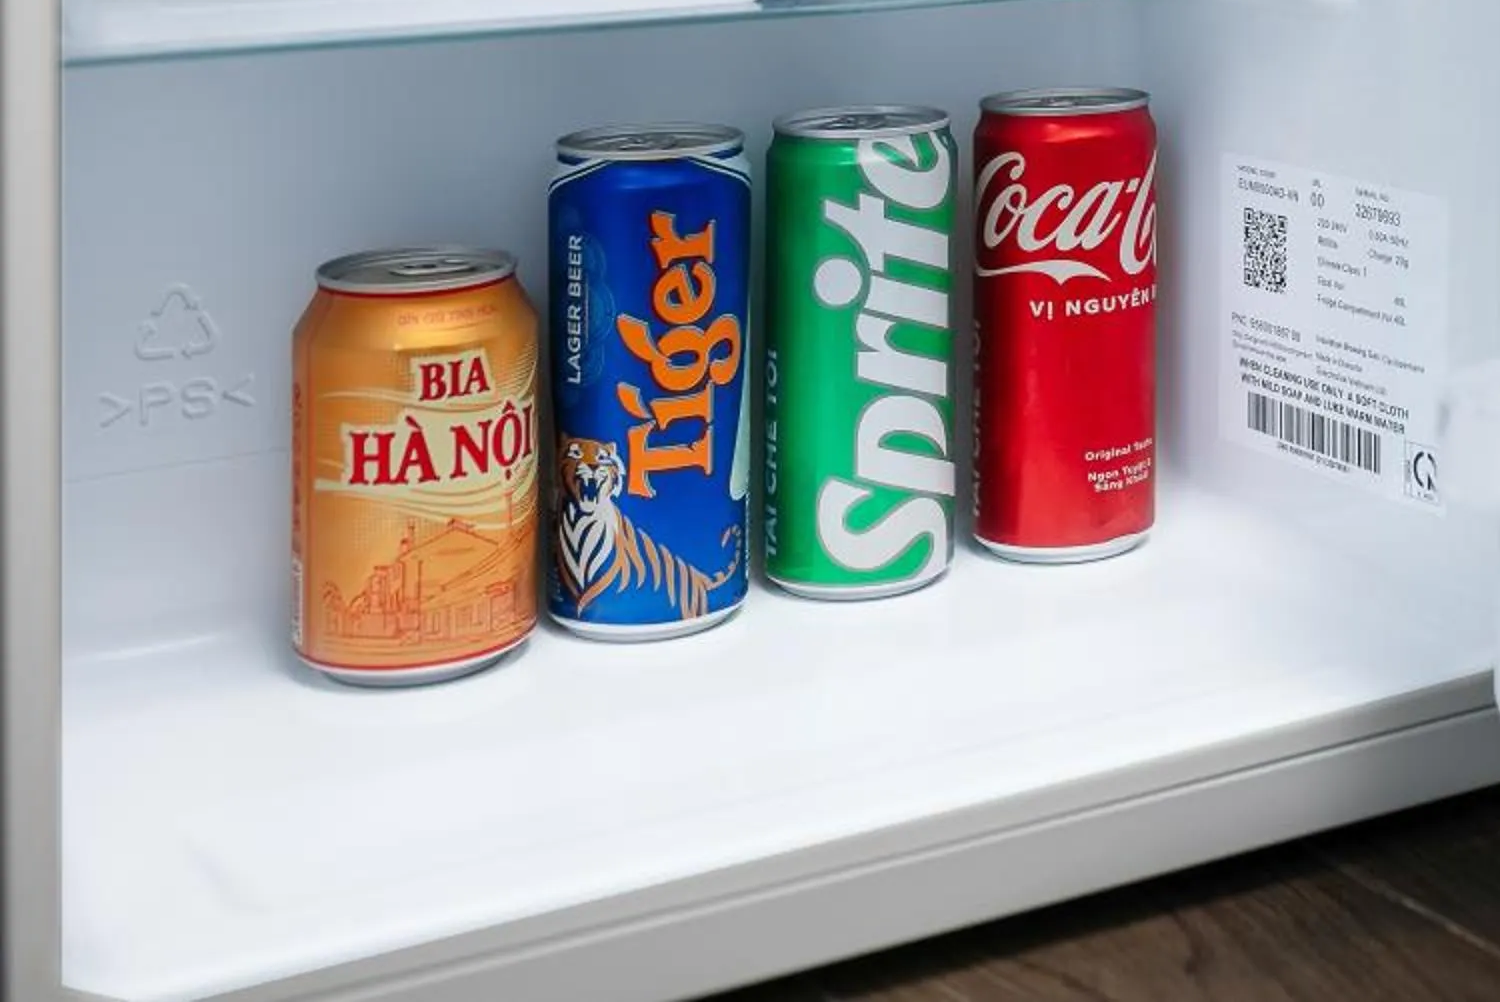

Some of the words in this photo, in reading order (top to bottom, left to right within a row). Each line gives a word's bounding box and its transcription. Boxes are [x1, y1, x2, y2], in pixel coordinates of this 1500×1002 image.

[568, 235, 583, 298] BEER
[1029, 300, 1053, 320] VỊ
[1065, 287, 1150, 316] NGUYÊN
[567, 305, 582, 384] LAGER
[616, 210, 741, 498] Tiger
[813, 132, 956, 576] Sprite
[419, 356, 490, 401] BIA
[1261, 377, 1280, 392] MILD
[1281, 384, 1303, 400] SOAP
[1304, 391, 1322, 407] AND
[1374, 413, 1405, 434] WATER
[1264, 362, 1303, 385] CLEANING
[1303, 376, 1320, 391] USE
[1321, 382, 1343, 399] ONLY
[1355, 393, 1377, 410] SOFT
[1378, 400, 1409, 420] CLOTH
[348, 415, 440, 485] HÀ
[450, 400, 534, 480] NỘI
[1085, 444, 1131, 461] Original
[1088, 470, 1118, 483] Ngon
